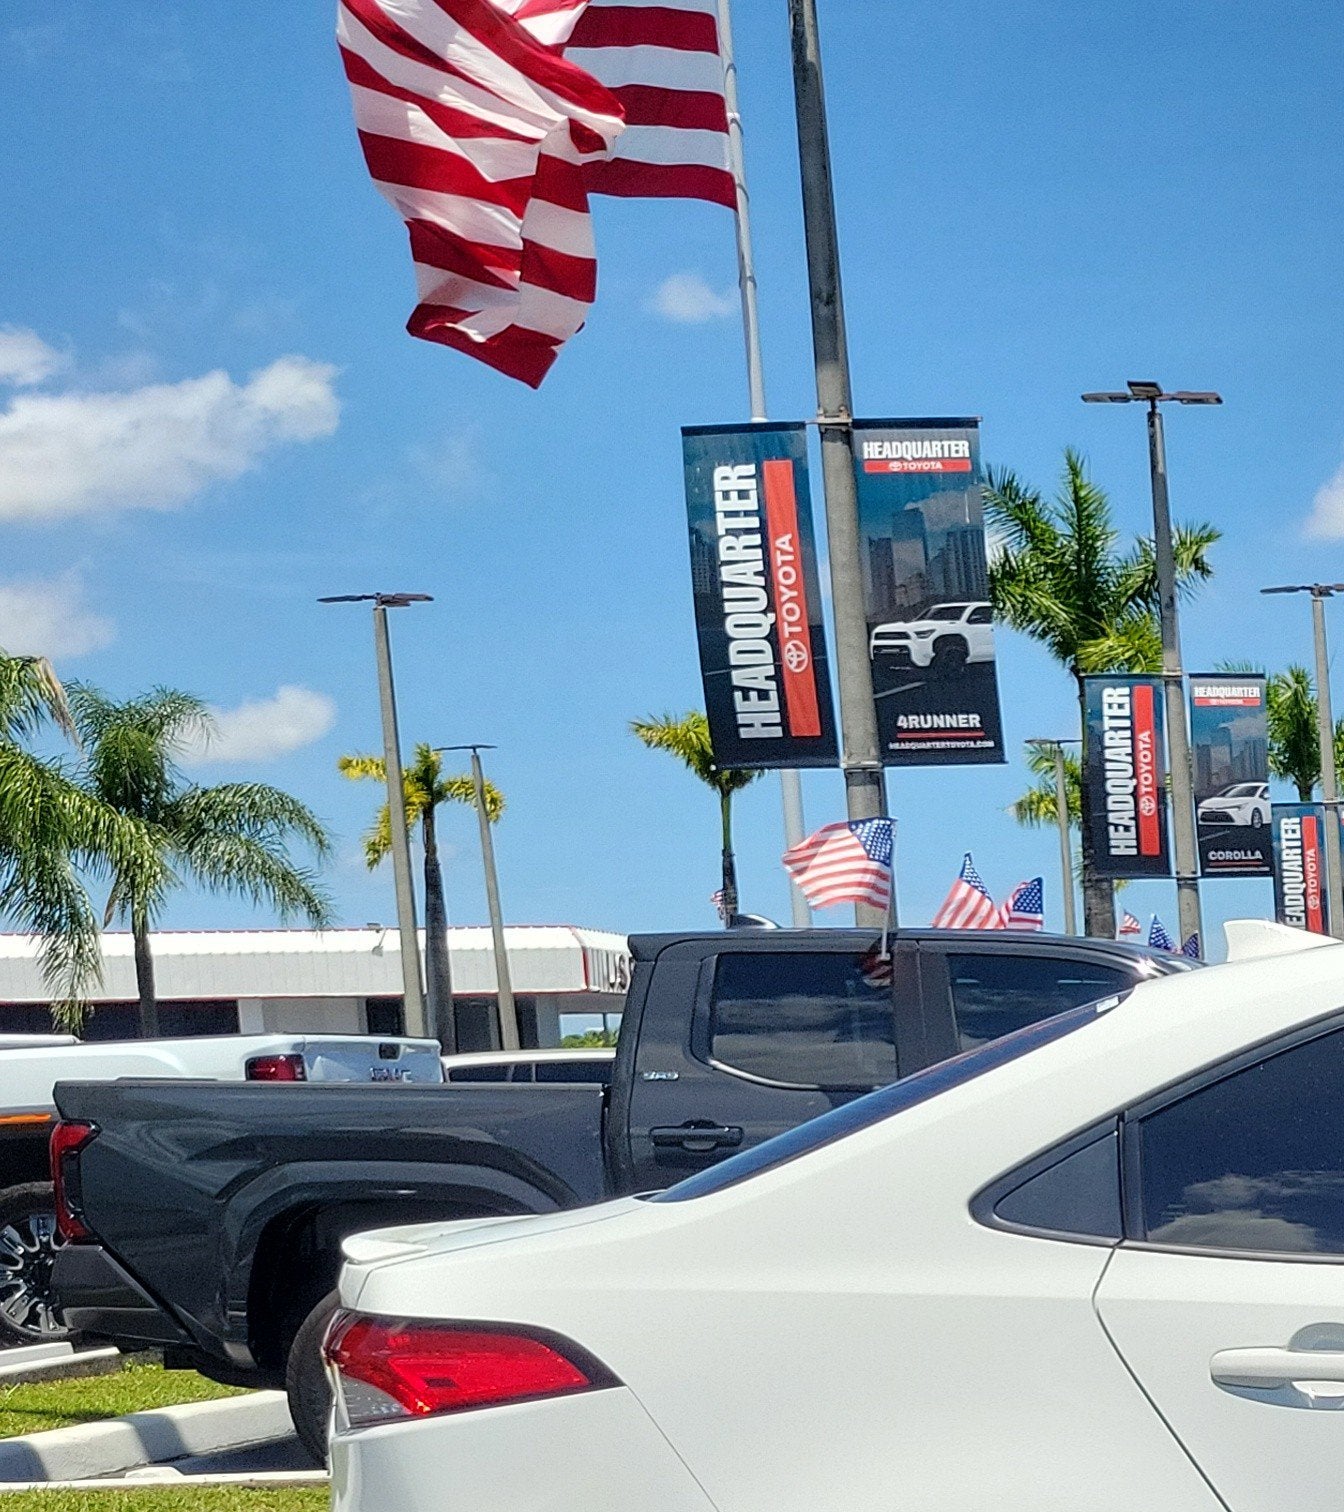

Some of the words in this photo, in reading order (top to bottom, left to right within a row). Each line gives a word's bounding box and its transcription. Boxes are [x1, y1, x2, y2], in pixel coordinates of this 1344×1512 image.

[863, 440, 970, 460] HEADQUARTER
[902, 461, 943, 470] TOYOTA
[713, 463, 783, 739] HEADQUARTER
[775, 533, 804, 638] TOYOTA
[896, 714, 981, 729] 4RUNNER
[1102, 687, 1137, 855] HEADQUARTER
[1138, 731, 1153, 795] TOYOTA
[1208, 850, 1263, 860] COROLLA
[1306, 849, 1318, 895] TOYOTA
